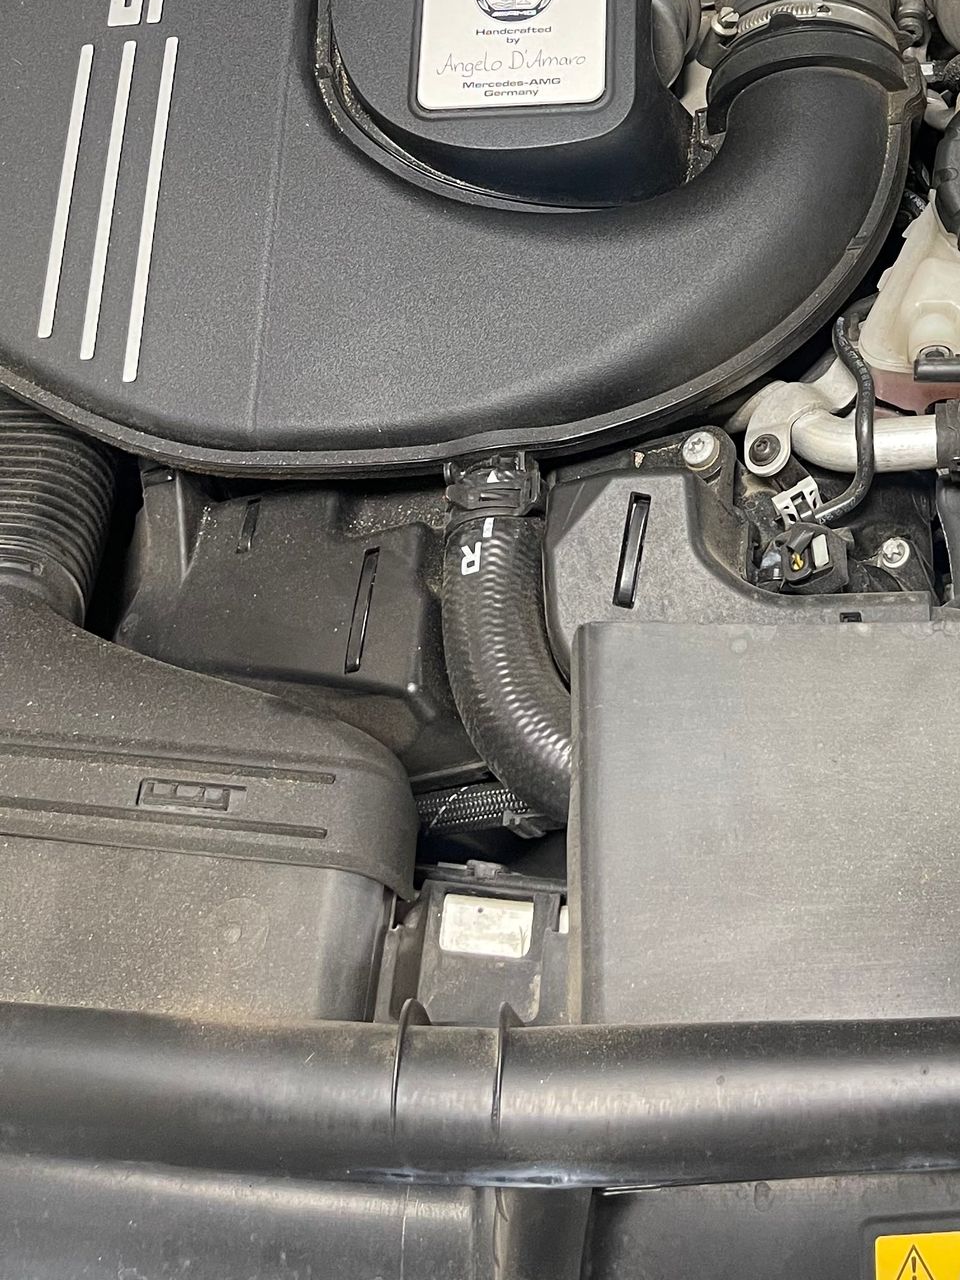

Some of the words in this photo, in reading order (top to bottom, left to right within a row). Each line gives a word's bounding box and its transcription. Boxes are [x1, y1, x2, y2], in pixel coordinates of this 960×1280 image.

[475, 26, 552, 36] Handcrafted
[506, 36, 520, 45] by
[436, 51, 503, 78] Angelo
[508, 48, 586, 70] D'Amaro
[462, 77, 562, 89] Mercedes-AMG
[484, 89, 539, 97] Germany
[461, 541, 482, 576] R
